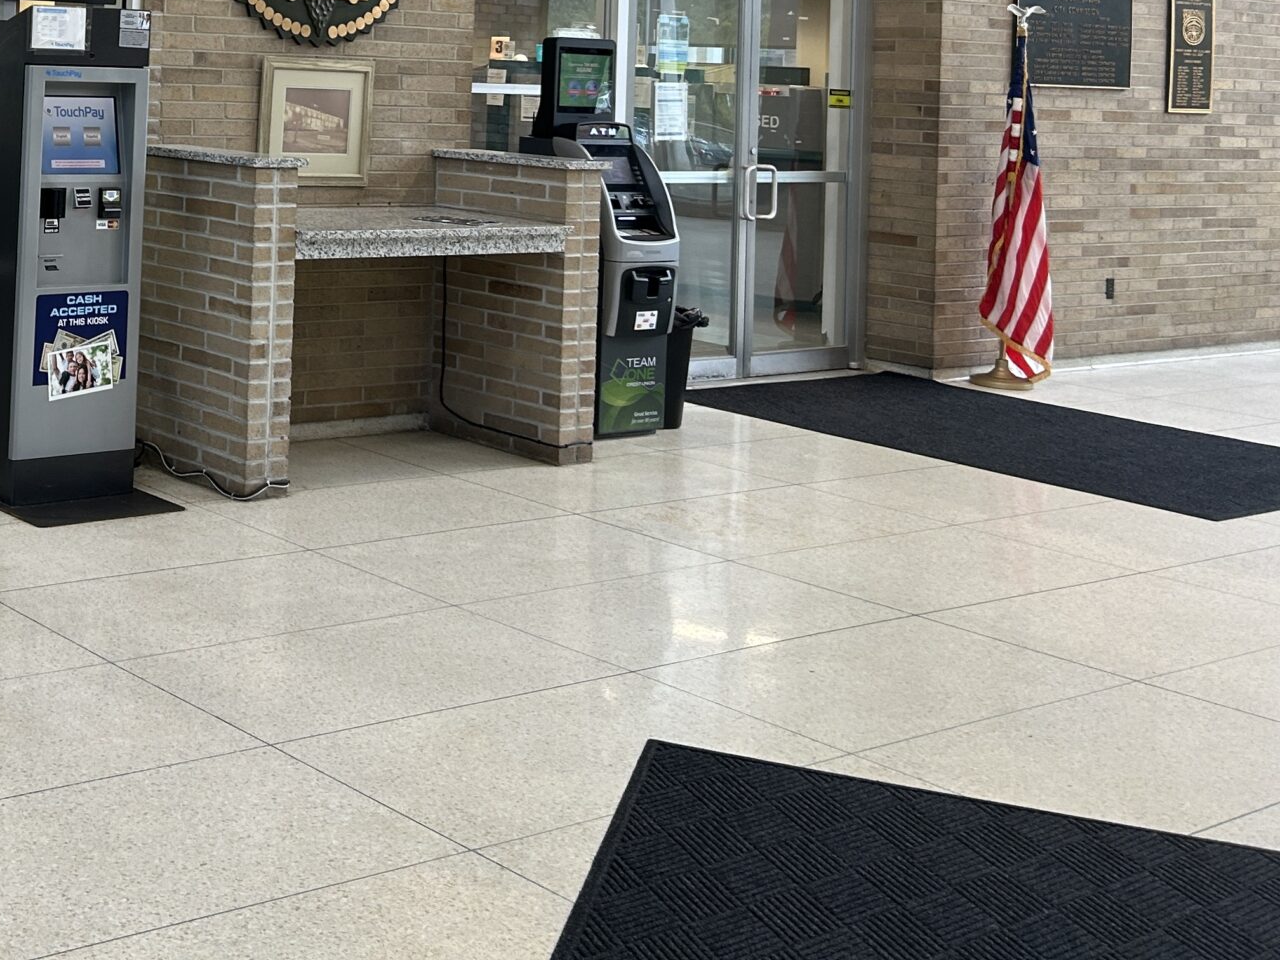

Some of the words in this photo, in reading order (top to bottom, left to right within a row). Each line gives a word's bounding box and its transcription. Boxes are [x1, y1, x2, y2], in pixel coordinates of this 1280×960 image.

[495, 40, 503, 54] 3
[53, 106, 104, 120] TouchPay
[589, 127, 617, 136] ATM
[66, 294, 102, 305] CASH
[49, 304, 117, 317] ACCEPTED
[57, 318, 68, 327] AT
[68, 317, 86, 327] THIS
[86, 316, 109, 326] KIOSK
[626, 356, 656, 368] TEAM
[626, 368, 656, 381] ONE
